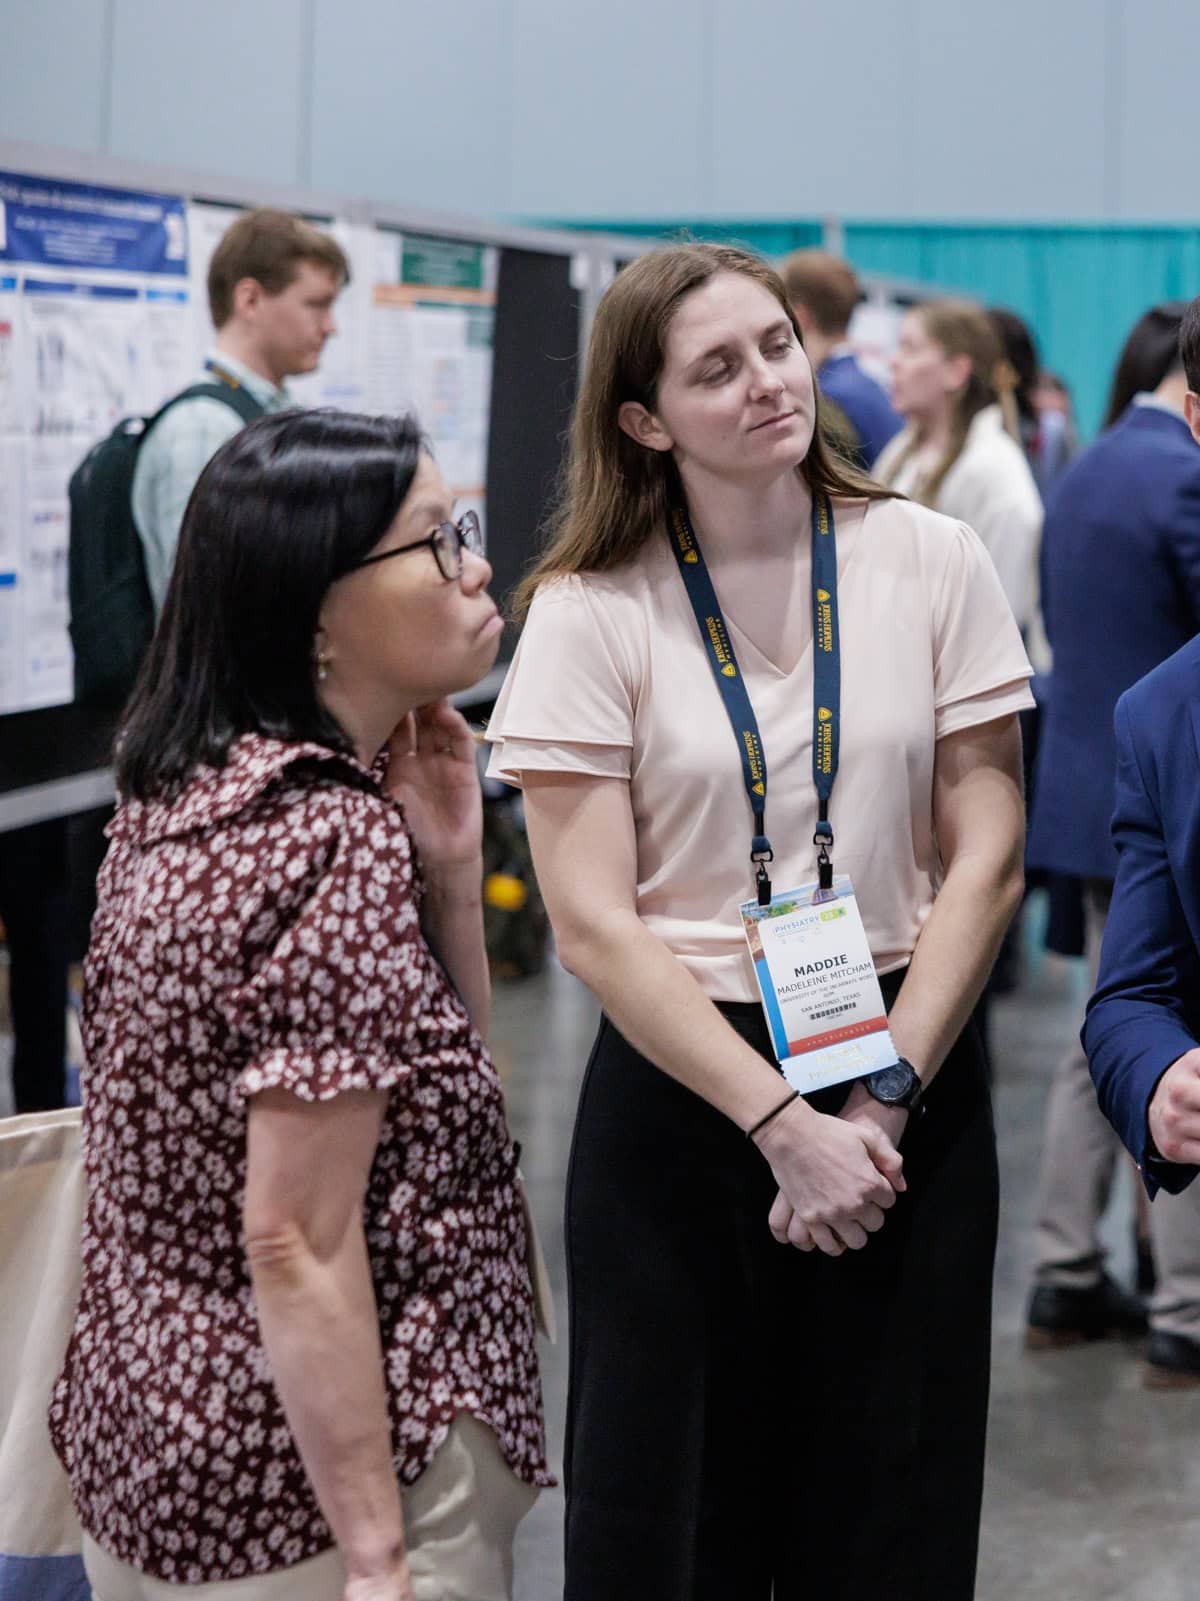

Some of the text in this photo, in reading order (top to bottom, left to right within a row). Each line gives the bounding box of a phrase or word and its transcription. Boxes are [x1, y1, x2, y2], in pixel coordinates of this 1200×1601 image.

[704, 616, 728, 664] JOHNS HOPKINS
[715, 618, 731, 658] MEDICINE
[821, 604, 832, 651] JOHNS HOPKINS
[742, 730, 760, 780] JOHNS HOPKINS
[821, 722, 831, 773] JOHNS HOPKINS
[778, 962, 872, 994] MADELEINE MITCHAM
[794, 954, 848, 977] MADDIE
[842, 992, 861, 1001] TEXAS
